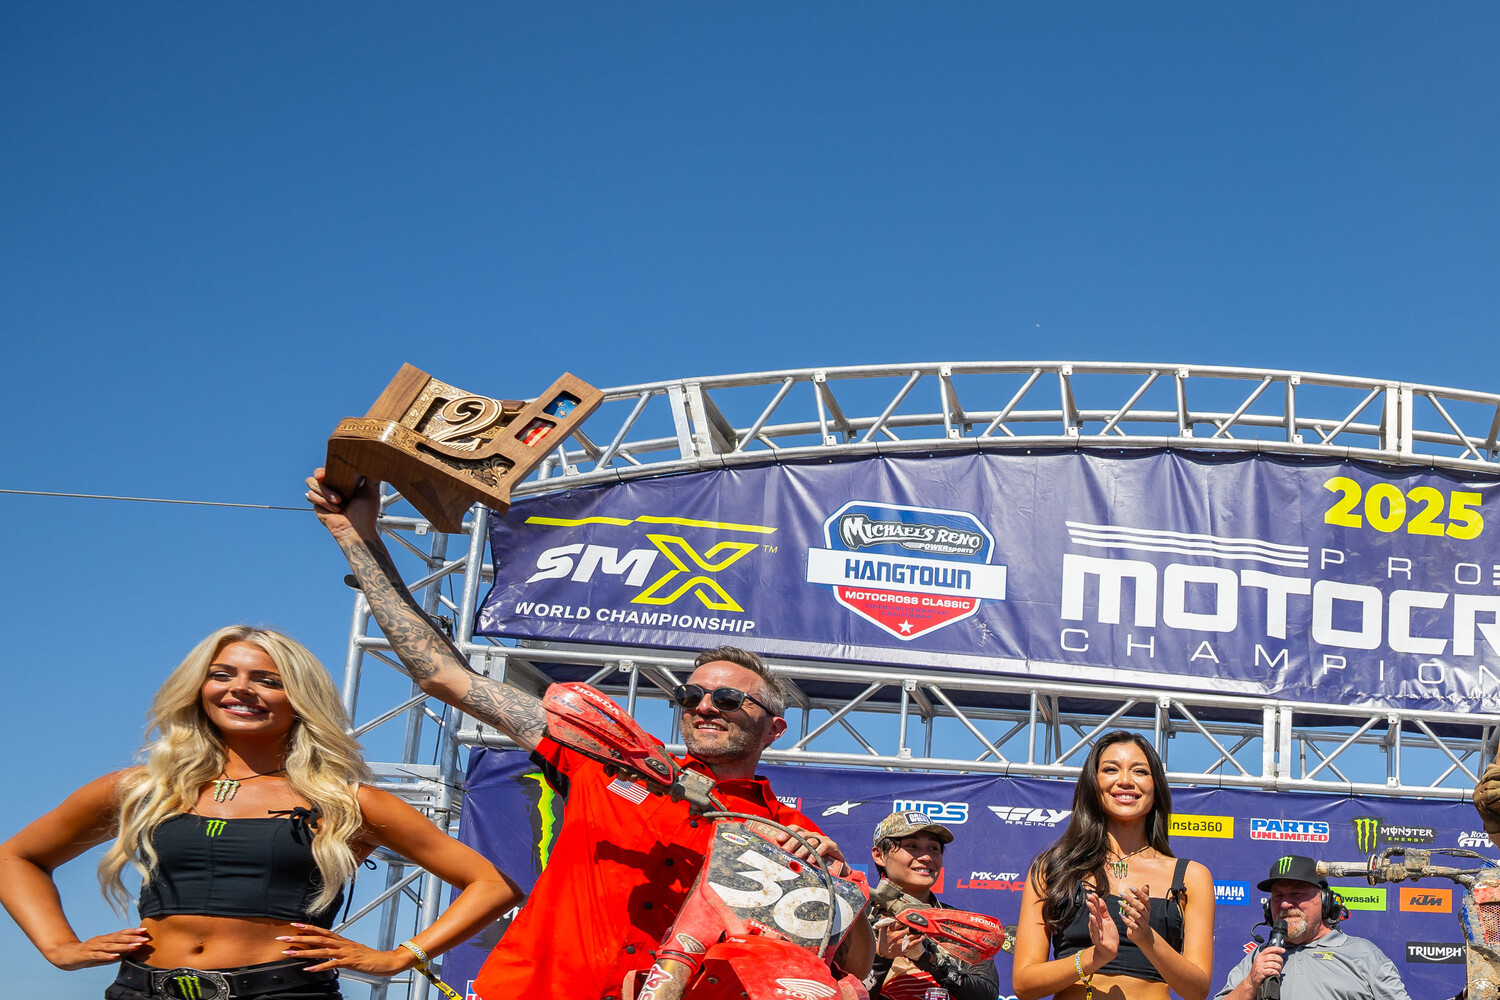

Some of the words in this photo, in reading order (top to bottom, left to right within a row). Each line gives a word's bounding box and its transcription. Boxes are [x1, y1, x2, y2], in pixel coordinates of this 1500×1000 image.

[1322, 475, 1484, 540] 2025
[935, 530, 982, 548] RENO
[525, 534, 759, 612] SMX
[845, 558, 971, 590] HANGTOWN
[1319, 548, 1483, 586] PRO
[845, 590, 919, 605] MOTOCROSS
[922, 597, 970, 610] CLASSIC
[514, 602, 591, 620] WORLD
[596, 608, 756, 633] CHAMPIONSHIP
[573, 684, 621, 717] HONDA
[1252, 818, 1329, 834] PARTS
[1381, 825, 1434, 838] MONSTER
[1251, 831, 1329, 842] UNLIMITED
[708, 849, 854, 940] 30
[1214, 885, 1245, 898] AMAHA
[1341, 895, 1380, 904] wasaki
[1409, 894, 1442, 906] KTM
[970, 915, 1001, 930] HONDA
[1407, 946, 1463, 960] TRIUMPH
